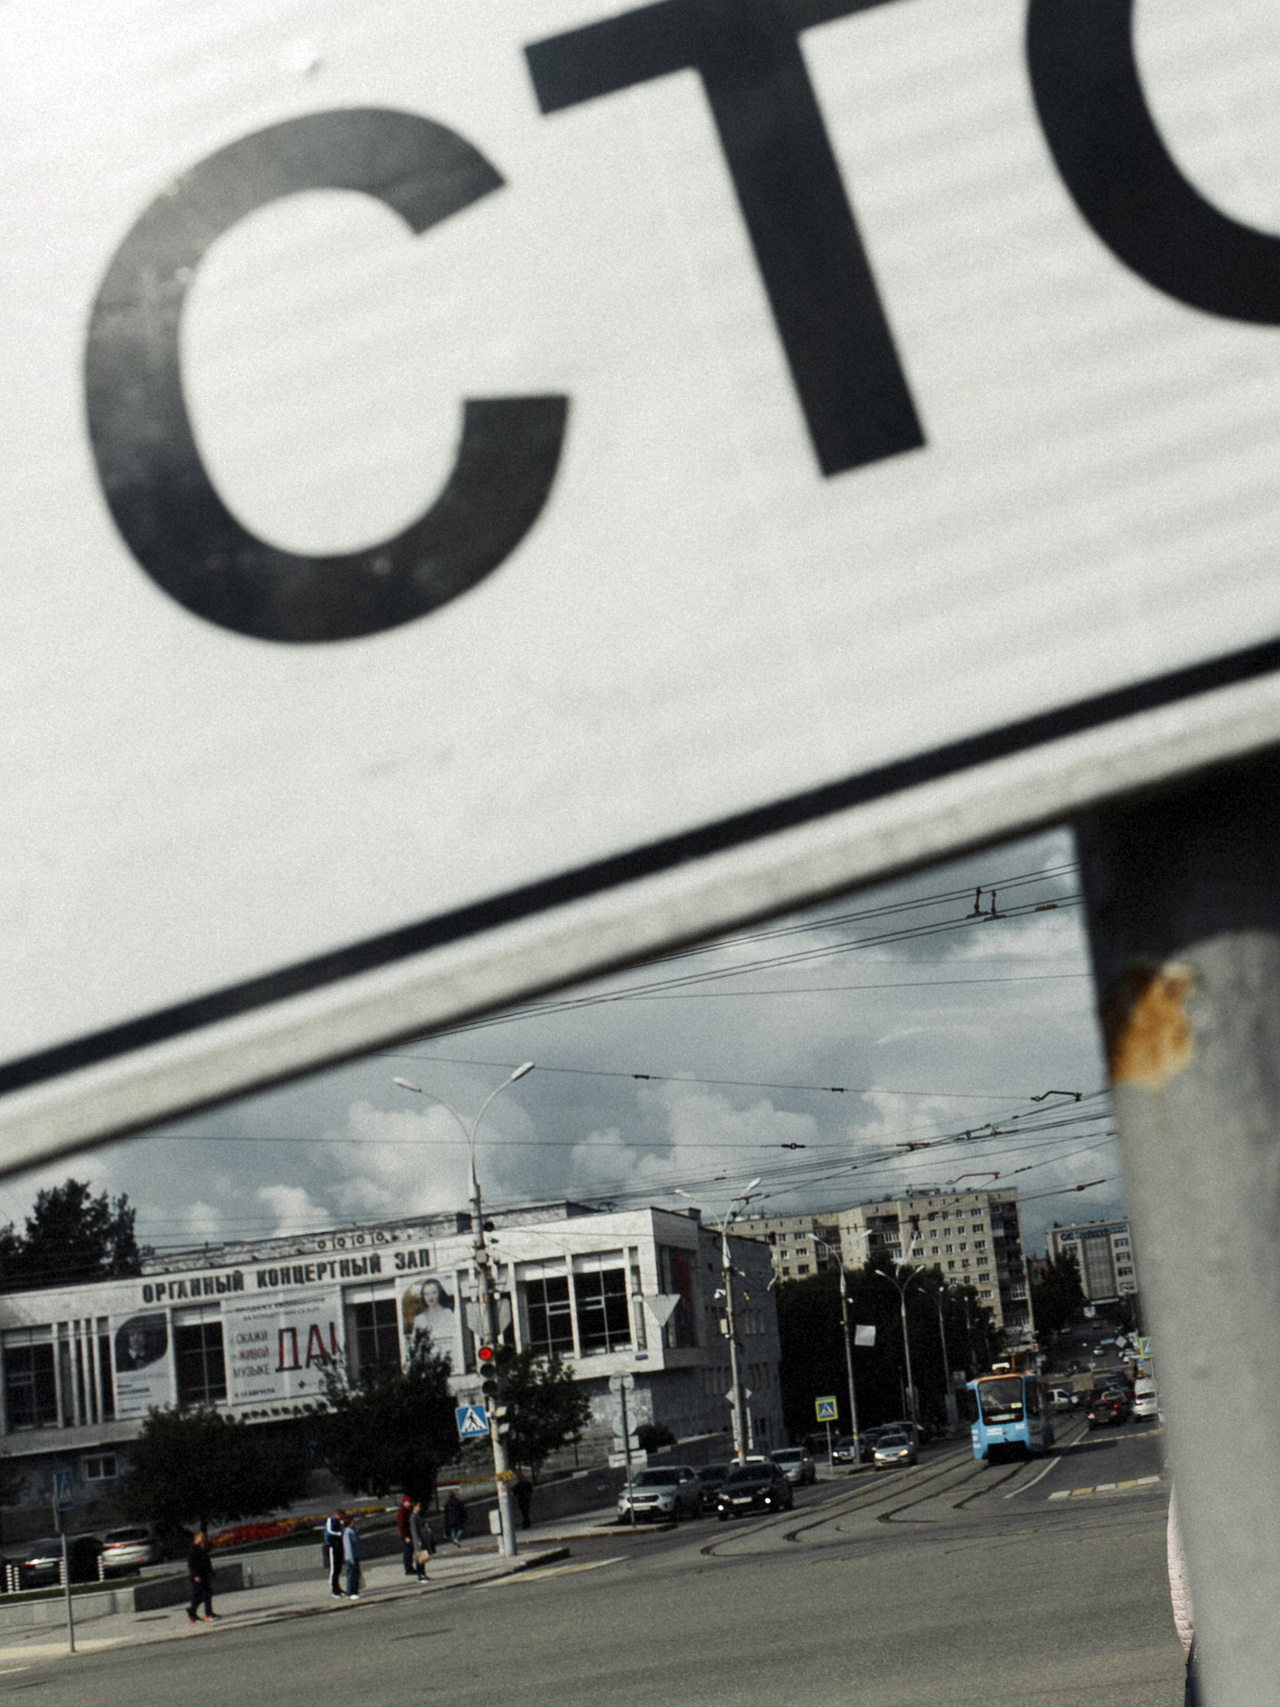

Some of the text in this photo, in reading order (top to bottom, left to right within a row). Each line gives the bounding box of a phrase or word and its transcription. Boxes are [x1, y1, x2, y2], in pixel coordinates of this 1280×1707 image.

[142, 1270, 245, 1304] ОРГАННЫЙ
[256, 1252, 382, 1290] КОНЦЕРТНЫЙ
[275, 1321, 338, 1373] ДА!
